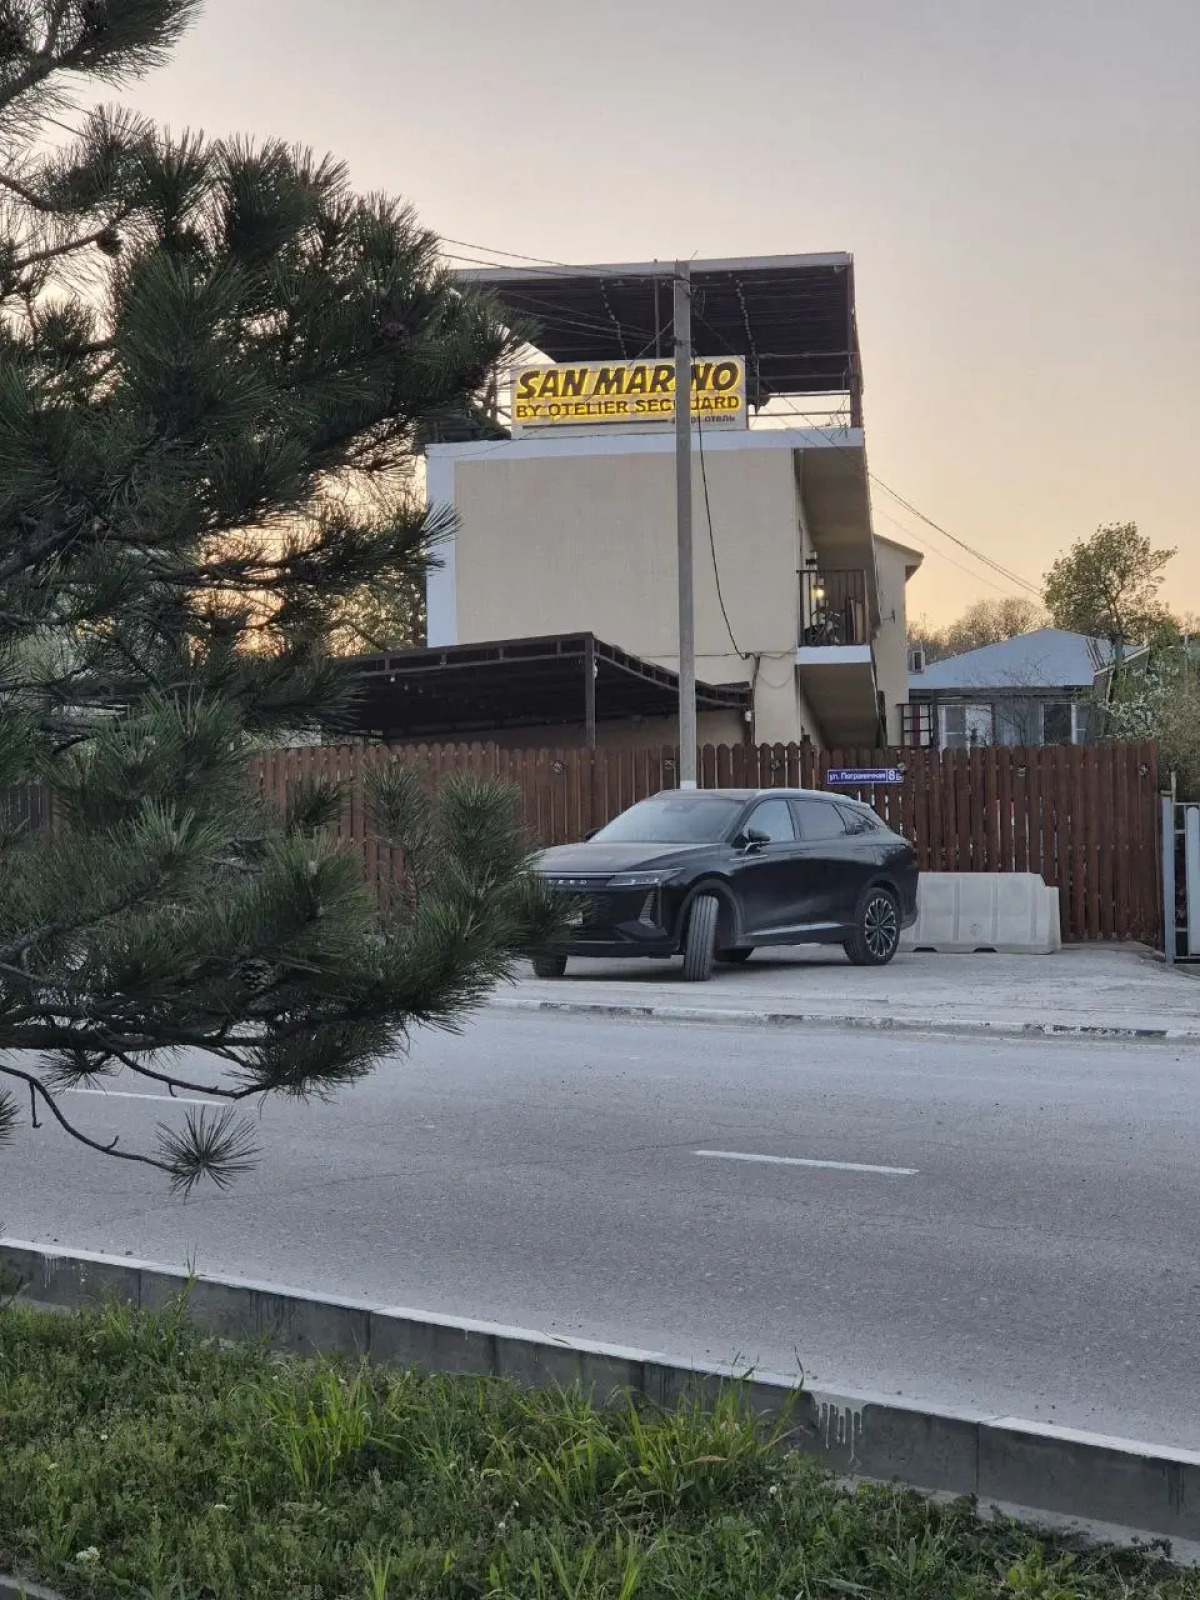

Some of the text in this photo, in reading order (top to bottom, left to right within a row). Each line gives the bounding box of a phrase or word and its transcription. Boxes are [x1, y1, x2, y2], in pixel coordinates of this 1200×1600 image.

[516, 362, 738, 399] SAN MARNO
[516, 404, 542, 418] BY
[548, 400, 628, 416] OTELIER
